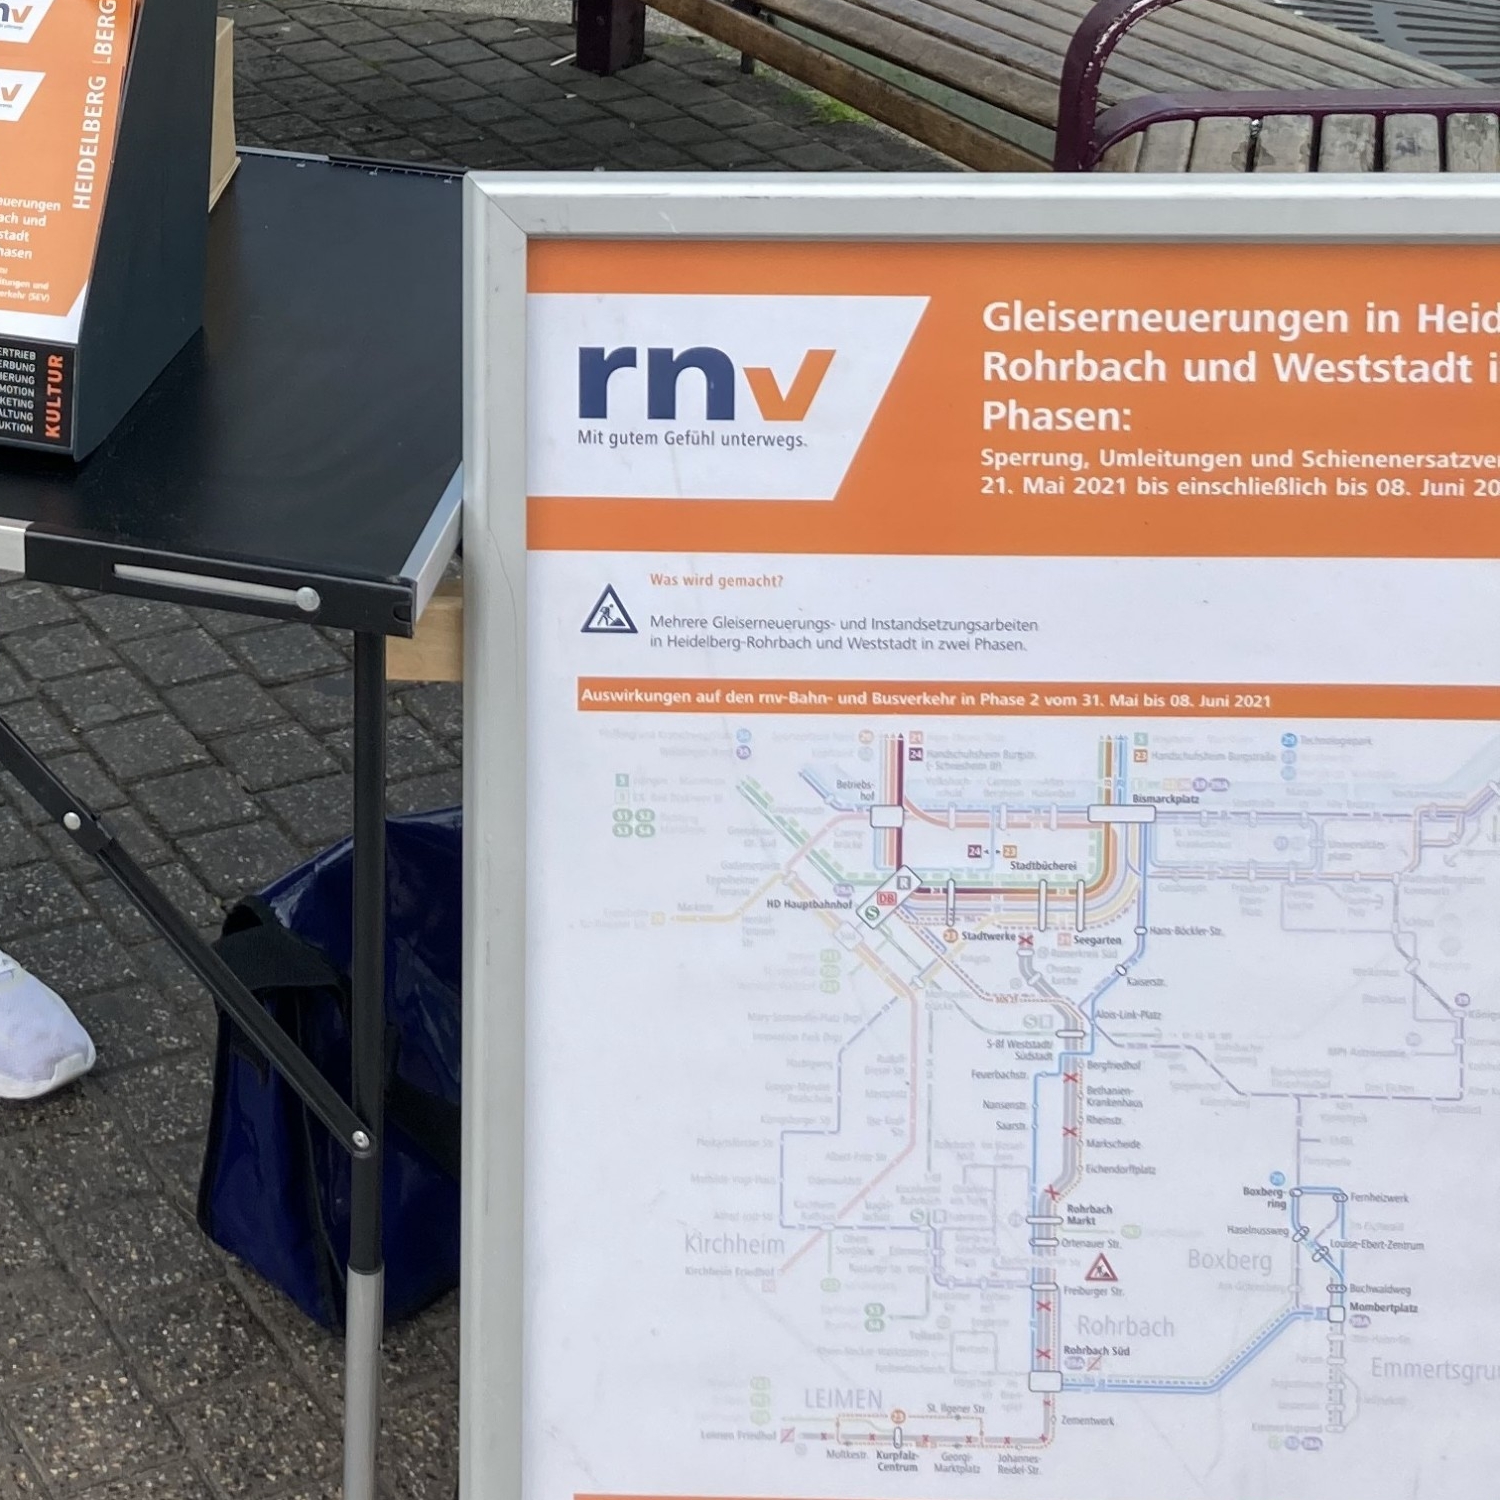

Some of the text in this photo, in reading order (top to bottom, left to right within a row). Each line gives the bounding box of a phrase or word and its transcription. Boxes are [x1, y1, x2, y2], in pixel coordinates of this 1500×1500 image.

[72, 74, 107, 210] HEIDELBERG
[982, 299, 1500, 342] Gleiserneuerungen in Heid
[983, 349, 1500, 384] Rohrbach und Weststadt i
[578, 346, 837, 421] rnv
[45, 354, 64, 439] KULTUR
[982, 398, 1132, 431] Phasen:
[577, 430, 808, 451] Mit gutem Gefühl unterwegs.
[980, 448, 1090, 471] Sperrung,
[1099, 448, 1243, 472] Umleitungen
[1251, 449, 1294, 468] und
[980, 476, 1014, 495] 21.
[1022, 476, 1065, 495] Mai
[1072, 476, 1126, 495] 2021
[1136, 476, 1169, 495] bis
[1177, 476, 1328, 496] einschließlich
[1335, 477, 1368, 496] bis
[1375, 478, 1412, 496] 08.
[1420, 477, 1465, 496] Juni
[650, 573, 784, 590] Was wird gemacht?
[650, 615, 1039, 634] Mehrere Gleiserneuerungs- und Instandsetzungsarbeiten
[650, 634, 1028, 652] in Heidelberg-Rohrbach und Weststadt in zwei Phasen.
[581, 688, 1271, 708] Auswirkungen auf den rnv-Bahn- und Busverkehr in Phase 2 vom 31. Mai bis 08. Juni 2021
[836, 780, 875, 789] Betriebs-
[1132, 794, 1200, 805] Bismarckplatz
[1010, 860, 1077, 871] Stadtbücherei
[766, 900, 853, 911] HD Hauptbahnhof
[961, 931, 1016, 941] Stadtwerke
[1073, 936, 1122, 947] Seegarten
[1067, 1204, 1113, 1214] Rohrbach
[1067, 1216, 1096, 1226] Markt
[684, 1232, 786, 1256] Kirchheim
[1188, 1248, 1273, 1277] Boxberg
[1350, 1302, 1419, 1314] Mombertplatz
[1077, 1315, 1175, 1337] Rohrbach
[804, 1389, 883, 1410] LEIMEN
